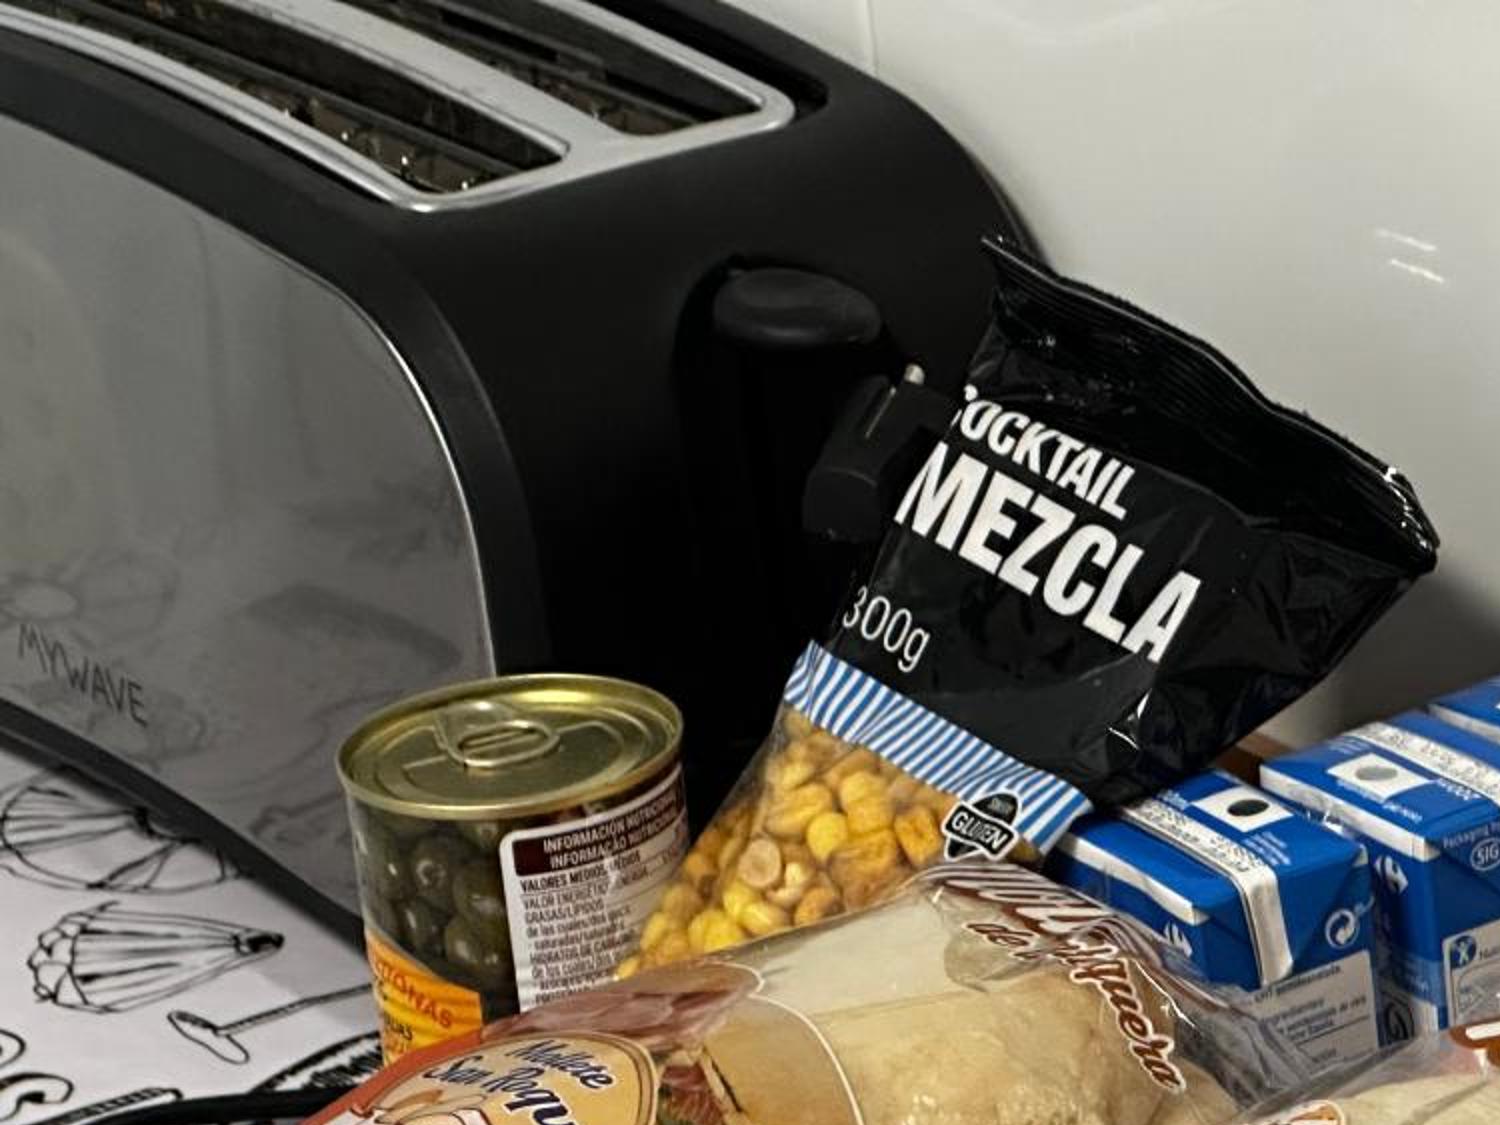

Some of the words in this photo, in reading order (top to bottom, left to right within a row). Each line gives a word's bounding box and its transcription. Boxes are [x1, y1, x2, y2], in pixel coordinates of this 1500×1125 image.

[951, 384, 1135, 521] OCKTAIL
[894, 440, 1202, 663] MEZCLA
[843, 585, 931, 673] 300g
[950, 811, 1009, 849] GLUTEN
